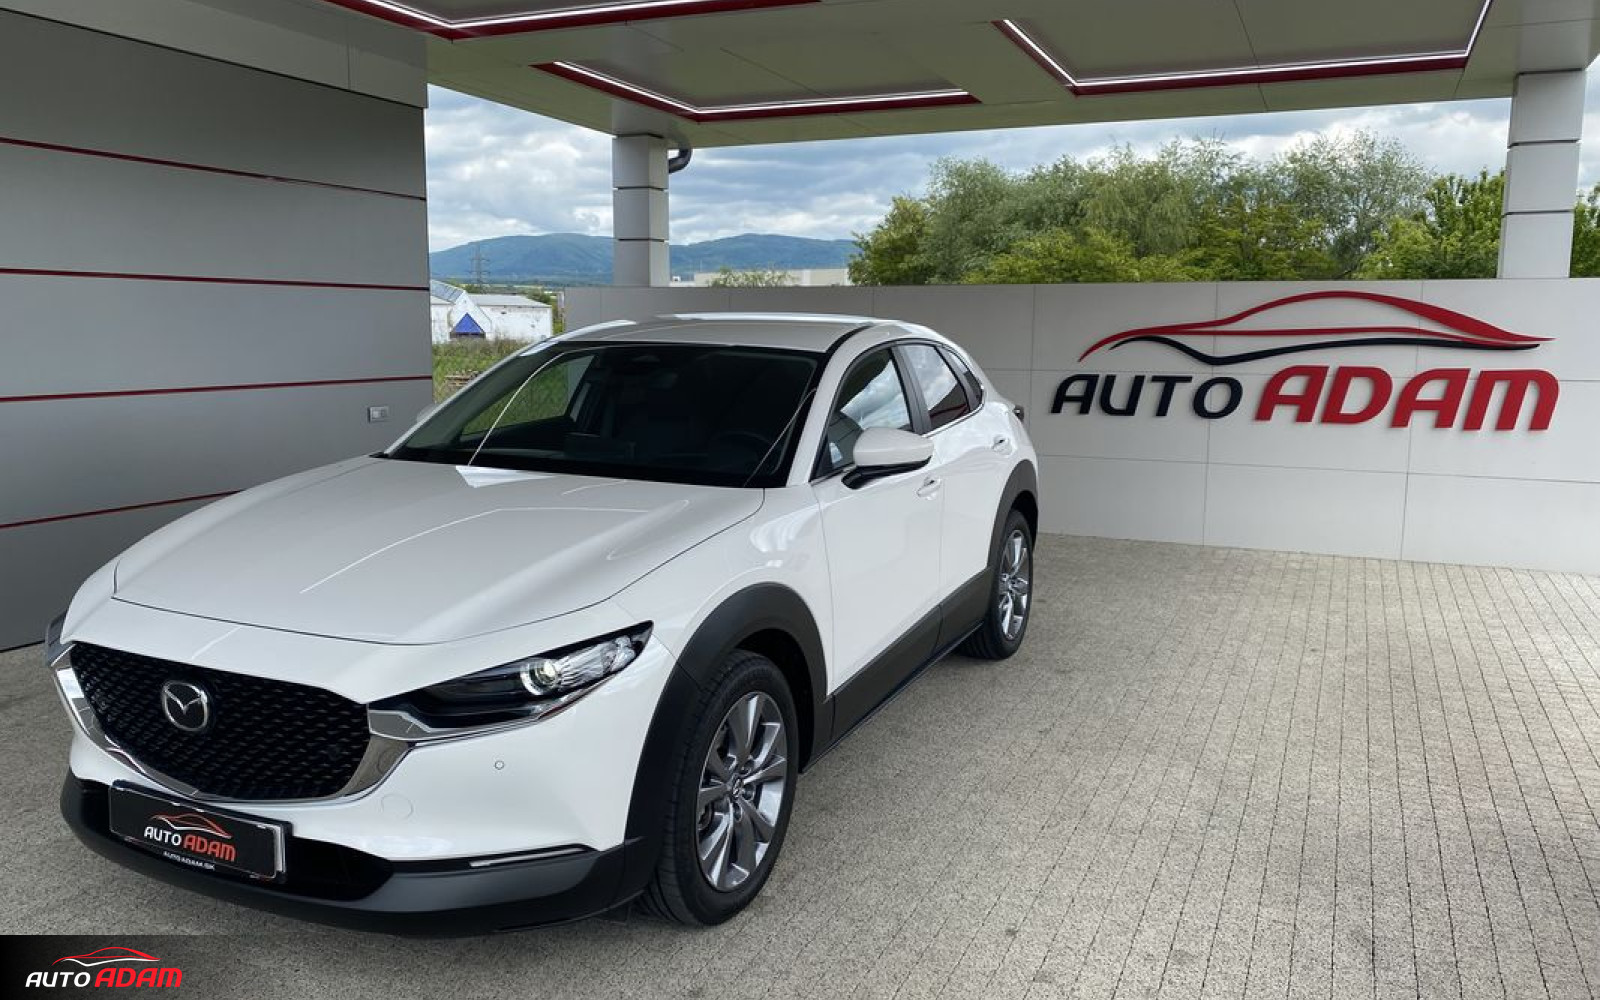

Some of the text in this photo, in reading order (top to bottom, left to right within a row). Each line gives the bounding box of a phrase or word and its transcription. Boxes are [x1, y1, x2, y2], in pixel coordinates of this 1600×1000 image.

[1051, 365, 1559, 431] AUTO ADAM
[144, 826, 237, 862] AUTO ADAM
